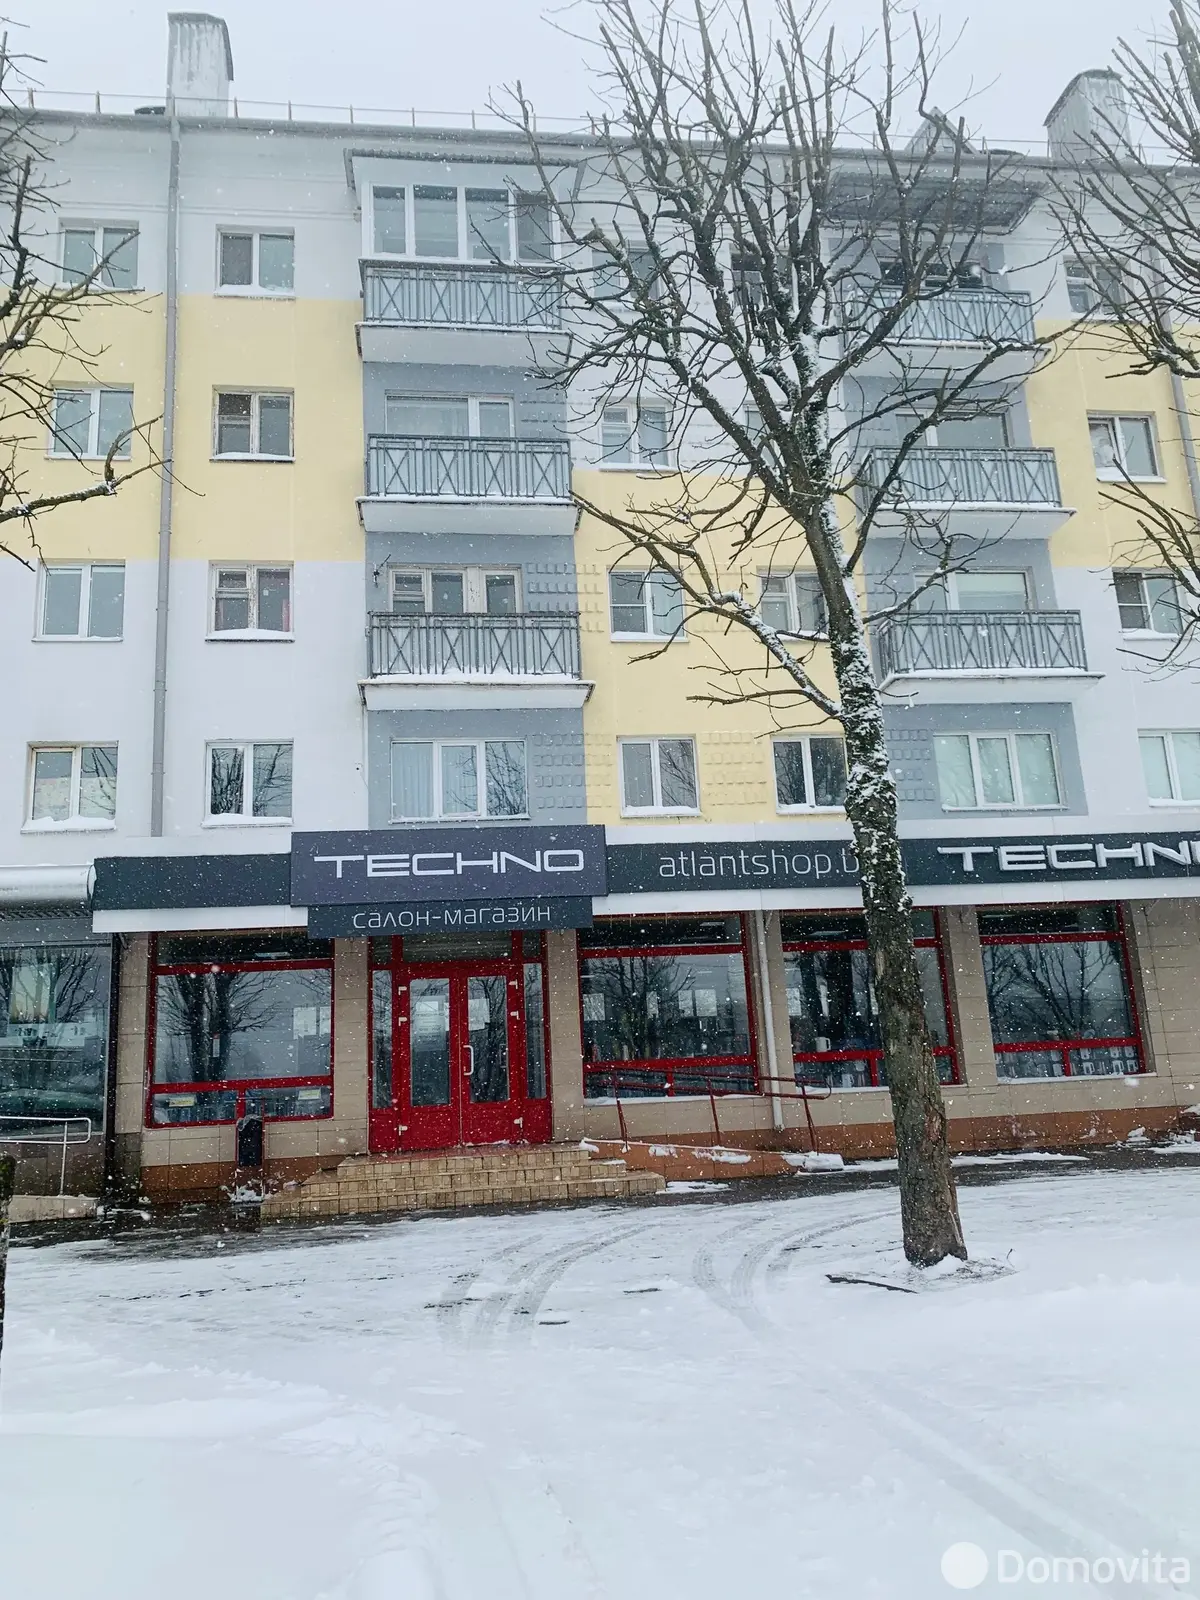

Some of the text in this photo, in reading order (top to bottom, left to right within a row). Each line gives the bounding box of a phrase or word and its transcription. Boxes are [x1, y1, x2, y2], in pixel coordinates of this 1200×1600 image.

[313, 849, 585, 879] TECHNO
[658, 847, 861, 881] atlantshop.b
[937, 840, 1200, 872] TECHN
[352, 906, 551, 929] салон-магазин
